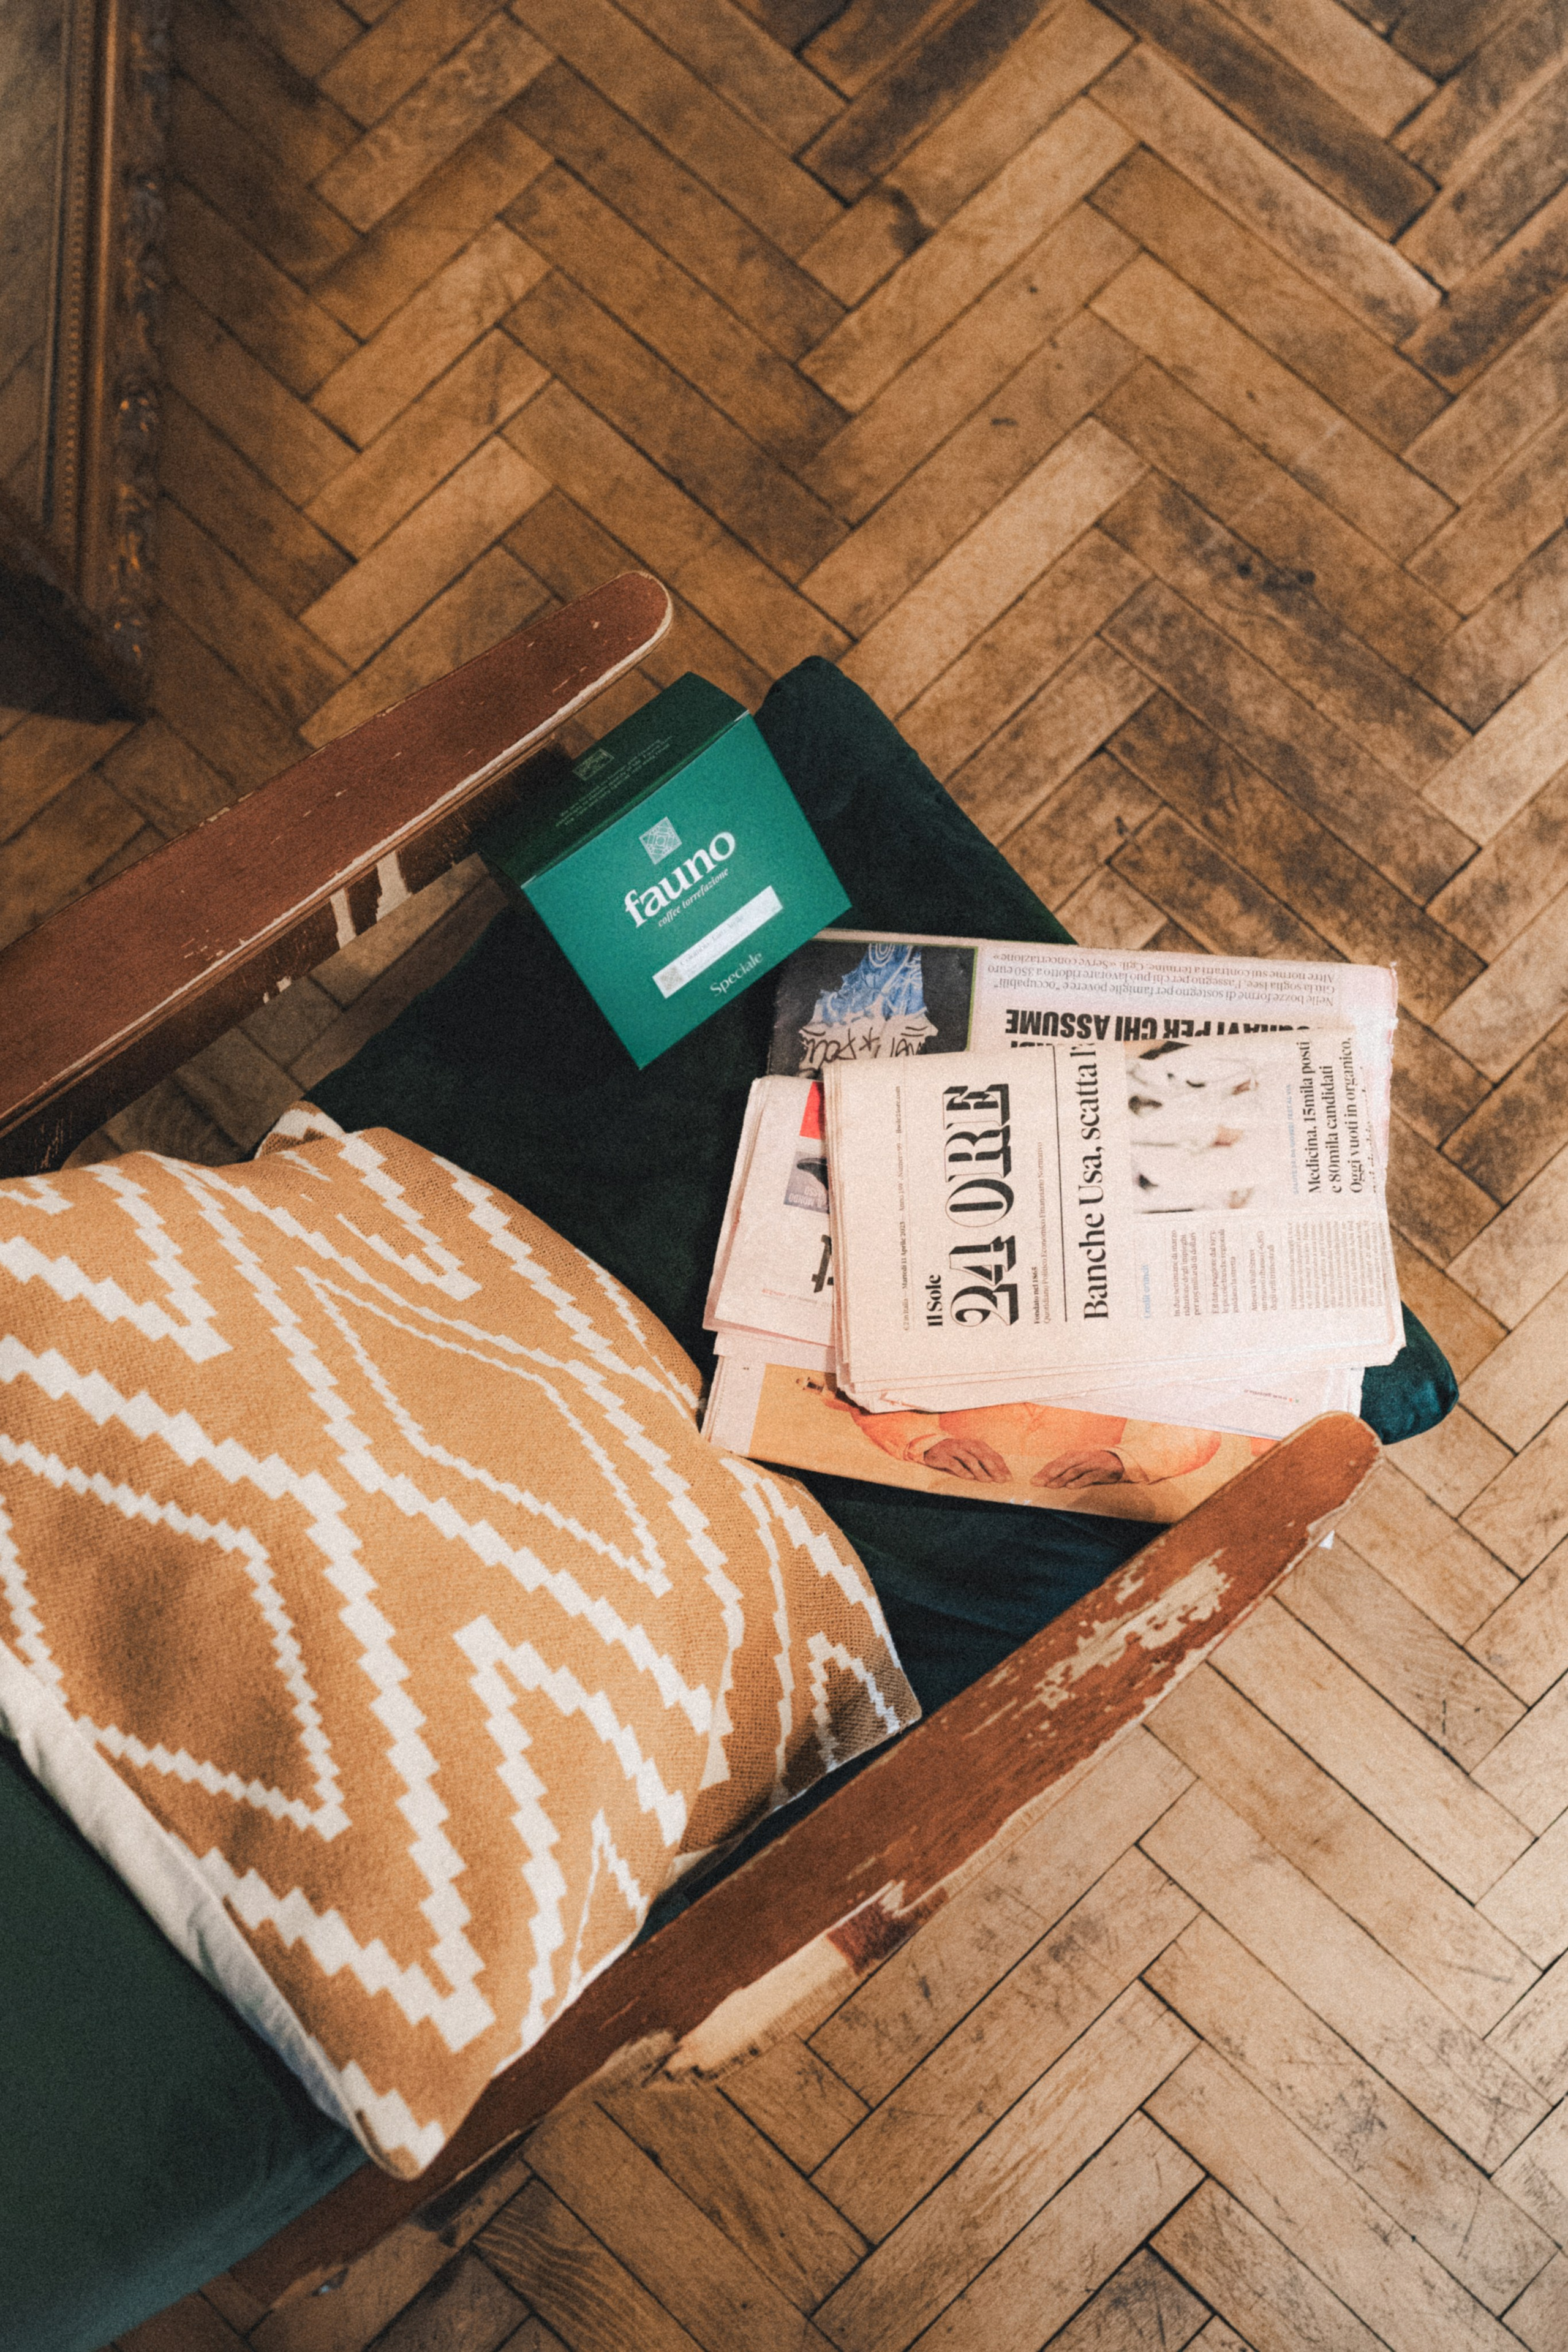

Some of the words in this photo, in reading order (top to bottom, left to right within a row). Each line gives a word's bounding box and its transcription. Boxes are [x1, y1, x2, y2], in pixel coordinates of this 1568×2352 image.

[625, 832, 735, 927] fauno
[658, 907, 680, 927] coffee
[677, 869, 728, 908] torrefazione
[710, 953, 762, 993] Speciale
[987, 964, 1012, 973] euro
[1013, 966, 1034, 976] 350
[1042, 967, 1080, 979] ridotto
[1082, 970, 1128, 982] lavorare
[1152, 974, 1170, 984] chi
[1170, 974, 1189, 984] per
[1201, 967, 1249, 978] contratti
[1251, 970, 1267, 979] sui
[1268, 970, 1305, 980] norme
[1306, 972, 1332, 983] Altre
[1070, 979, 1108, 992] povere
[1109, 982, 1154, 997] famiglie
[1155, 982, 1174, 994] per
[1174, 986, 1224, 999] sostegno
[1225, 990, 1236, 1001] di
[1237, 991, 1271, 1003] forme
[1270, 980, 1302, 992] soglia
[1272, 993, 1304, 1005] bozze
[1305, 995, 1333, 1006] Nelle
[1004, 1008, 1110, 1040] ASSUME
[1114, 1014, 1158, 1042] CHI
[1161, 1017, 1212, 1043] PER
[1295, 1040, 1315, 1075] posti
[1337, 1036, 1359, 1101] organico,
[1074, 1061, 1101, 1141] scatta
[1298, 1077, 1316, 1123] 15mila
[1318, 1064, 1338, 1130] candidati
[1343, 1102, 1357, 1117] in
[1344, 1119, 1361, 1156] vuoti
[939, 1082, 1015, 1229] ORE
[1035, 1141, 1044, 1178] Normativo
[1302, 1125, 1322, 1193] Medicina,
[1324, 1131, 1342, 1183] 80mila
[1076, 1145, 1107, 1207] Usa,
[1331, 1185, 1343, 1194] e
[1347, 1158, 1366, 1194] Oggi
[1037, 1178, 1046, 1218] Finanziario
[1039, 1218, 1047, 1257] Economico
[1040, 1258, 1049, 1284] Politico
[1077, 1212, 1109, 1321] Banche
[924, 1273, 943, 1312] Sole
[946, 1234, 1019, 1328] 24
[1042, 1284, 1051, 1324] Quotidiano
[1182, 1283, 1190, 1316] riduzione
[926, 1314, 944, 1327] Il
